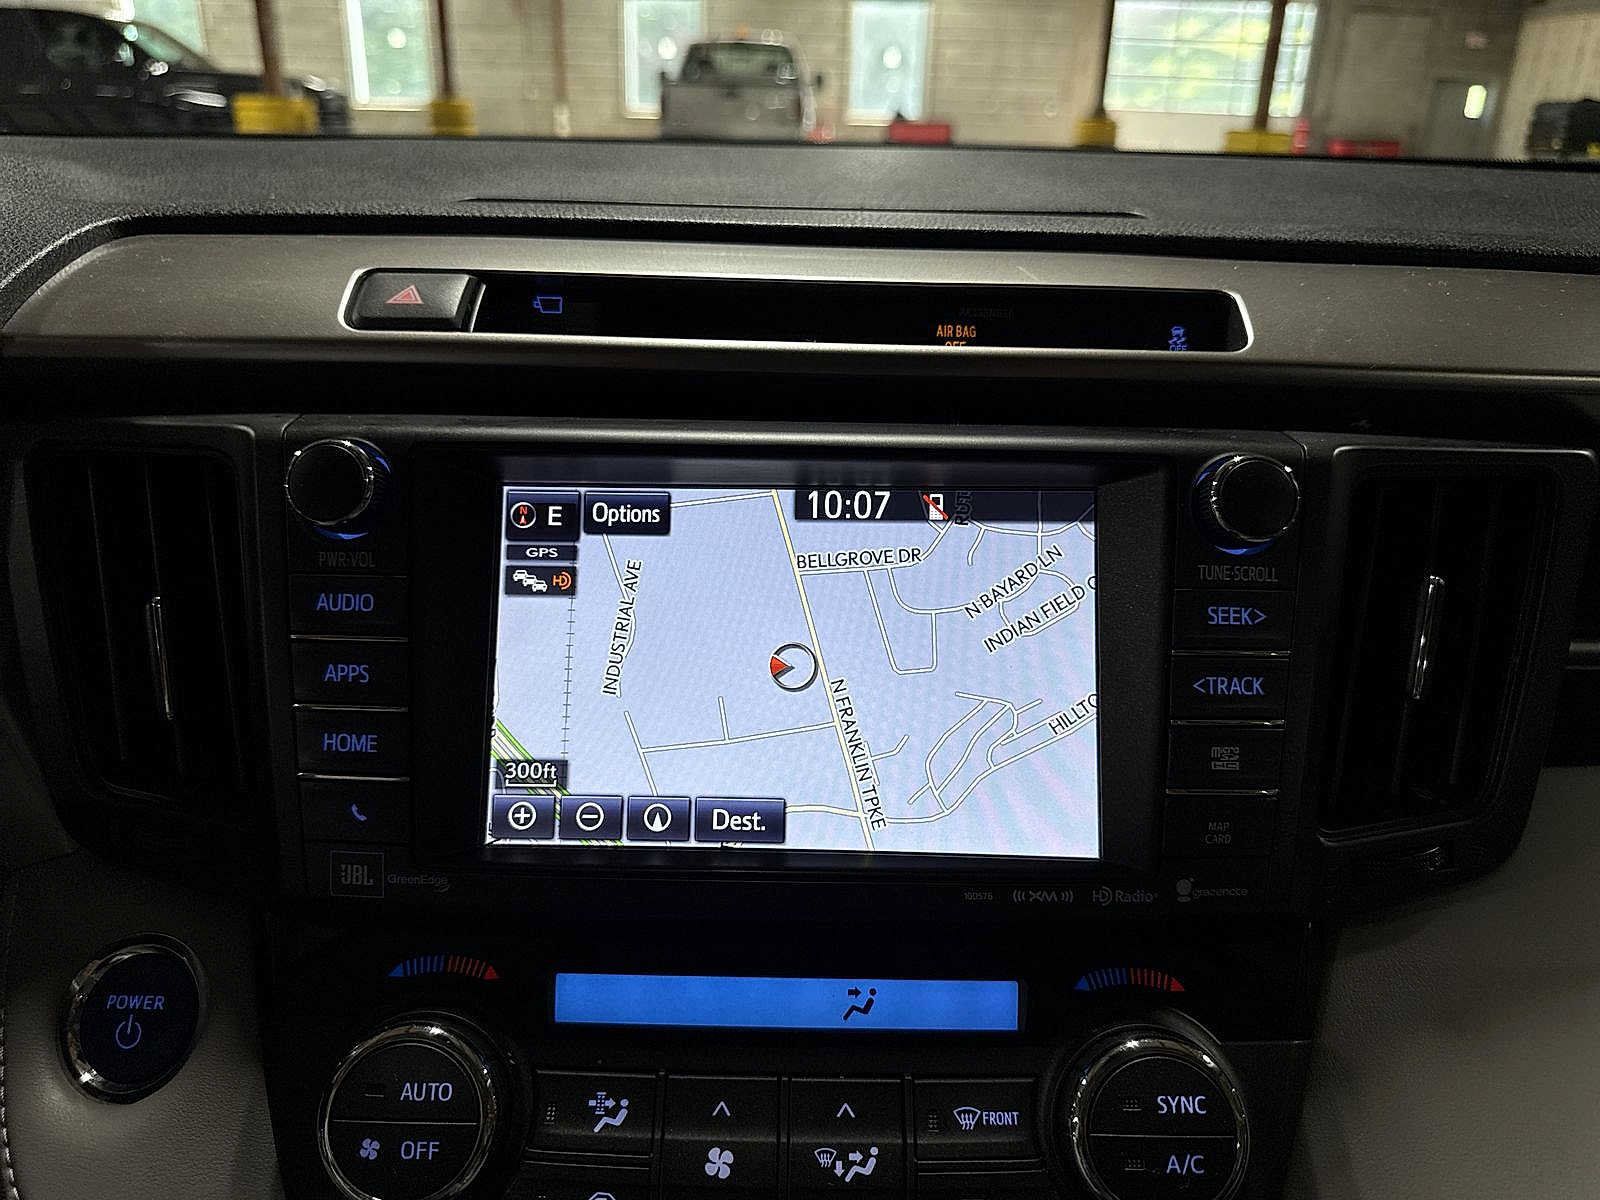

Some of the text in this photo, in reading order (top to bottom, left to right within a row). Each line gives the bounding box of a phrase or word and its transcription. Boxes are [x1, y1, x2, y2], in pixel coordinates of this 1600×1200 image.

[936, 325, 977, 338] AIR BAG
[592, 502, 660, 526] Options
[808, 490, 890, 519] 10:07
[548, 506, 562, 526] E
[525, 548, 558, 558] GPS
[797, 548, 921, 568] BELLGROVE DR
[964, 545, 1063, 619] N BAYARD LN
[316, 592, 375, 612] AUDIO
[602, 560, 642, 695] INDUSTRIAL AVE
[983, 611, 1041, 653] INDIAN
[1040, 585, 1086, 619] FIELD
[324, 663, 370, 683] APPS
[322, 733, 379, 753] HOME
[831, 679, 886, 831] N FRANKLIN TPKE
[505, 762, 557, 779] 300ft
[712, 808, 766, 831] Dest.
[1208, 821, 1230, 832] MAP
[1205, 833, 1232, 845] CARD
[340, 864, 376, 886] JBL
[1114, 890, 1153, 904] Radio
[106, 994, 165, 1010] POWER
[400, 1082, 453, 1102] AUTO
[1156, 1095, 1208, 1115] SYNC
[982, 1111, 1020, 1127] FRONT
[400, 1140, 440, 1161] OFF
[1166, 1154, 1205, 1175] A/C
